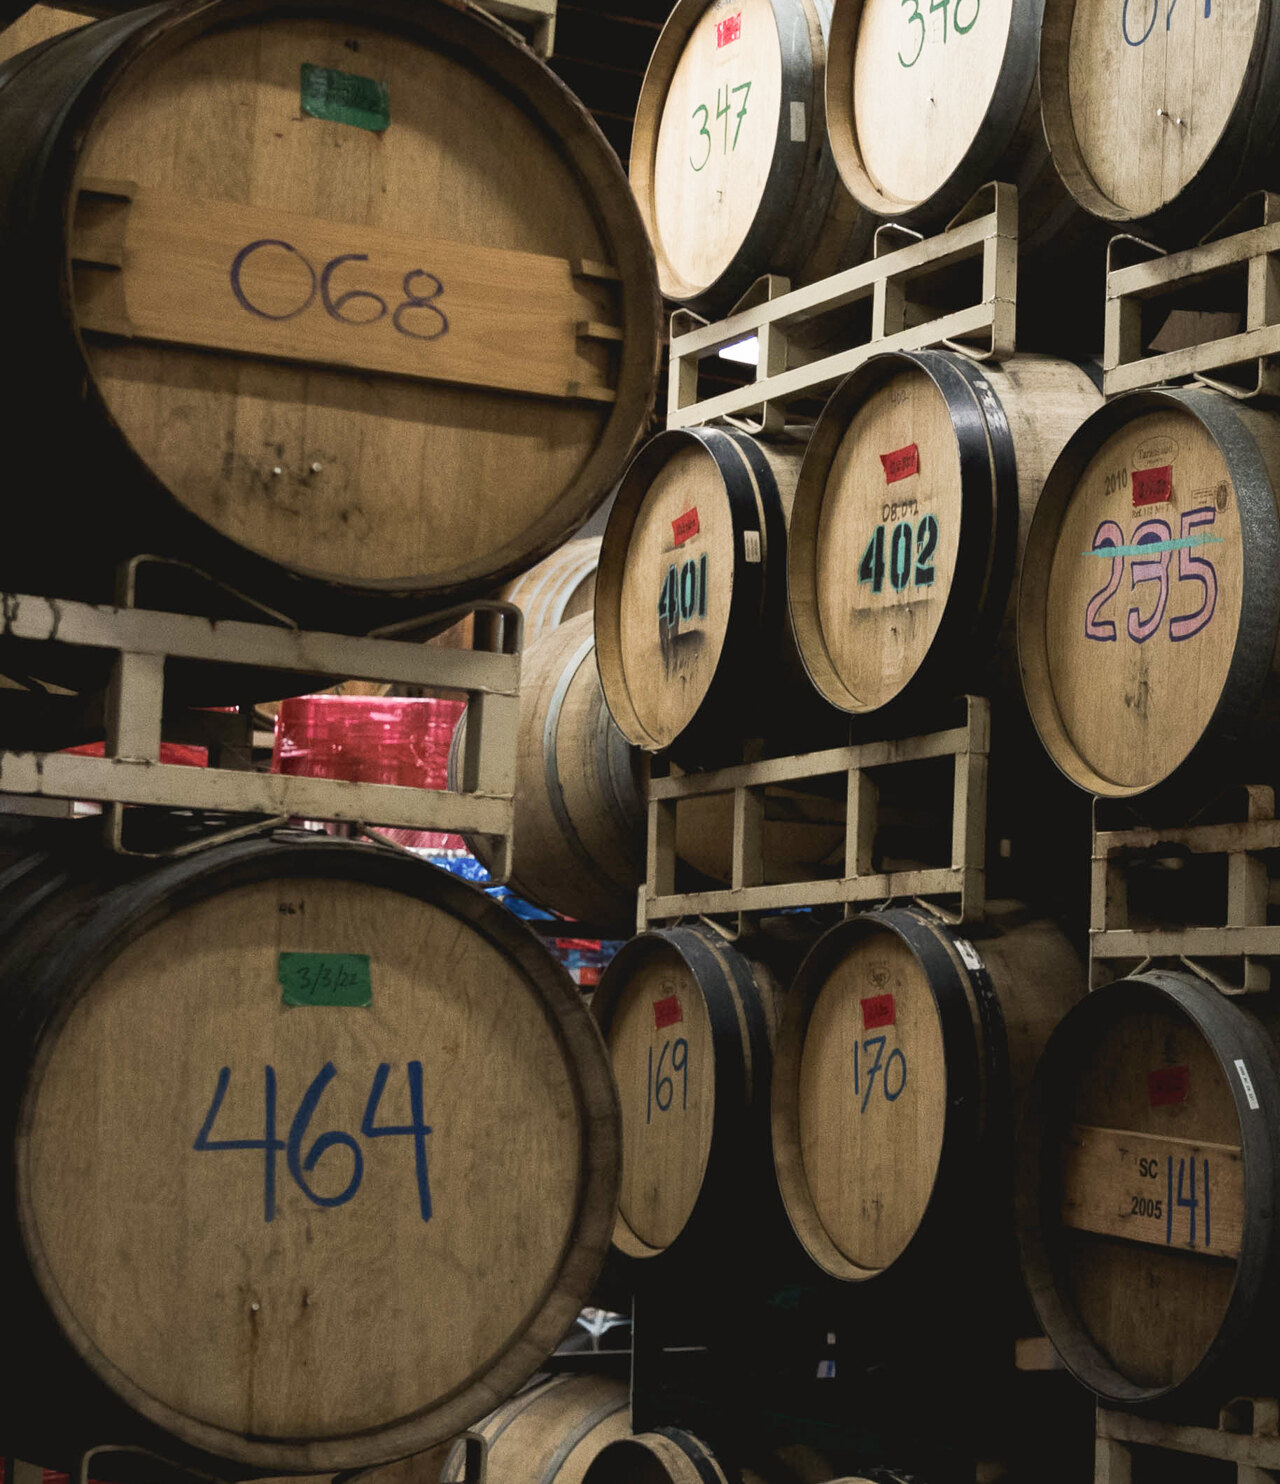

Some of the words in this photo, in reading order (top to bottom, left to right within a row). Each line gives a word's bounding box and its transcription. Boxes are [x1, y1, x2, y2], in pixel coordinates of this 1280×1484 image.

[689, 80, 752, 172] 347
[229, 238, 450, 341] 068
[657, 552, 708, 629] 401
[857, 512, 940, 596] 402
[1084, 506, 1219, 645] 235
[647, 1037, 689, 1125] 169
[854, 1035, 907, 1115] 170
[193, 1060, 433, 1223] 464
[1138, 1157, 1158, 1179] SC
[1131, 1196, 1163, 1220] 2005
[1166, 1155, 1210, 1247] 141
